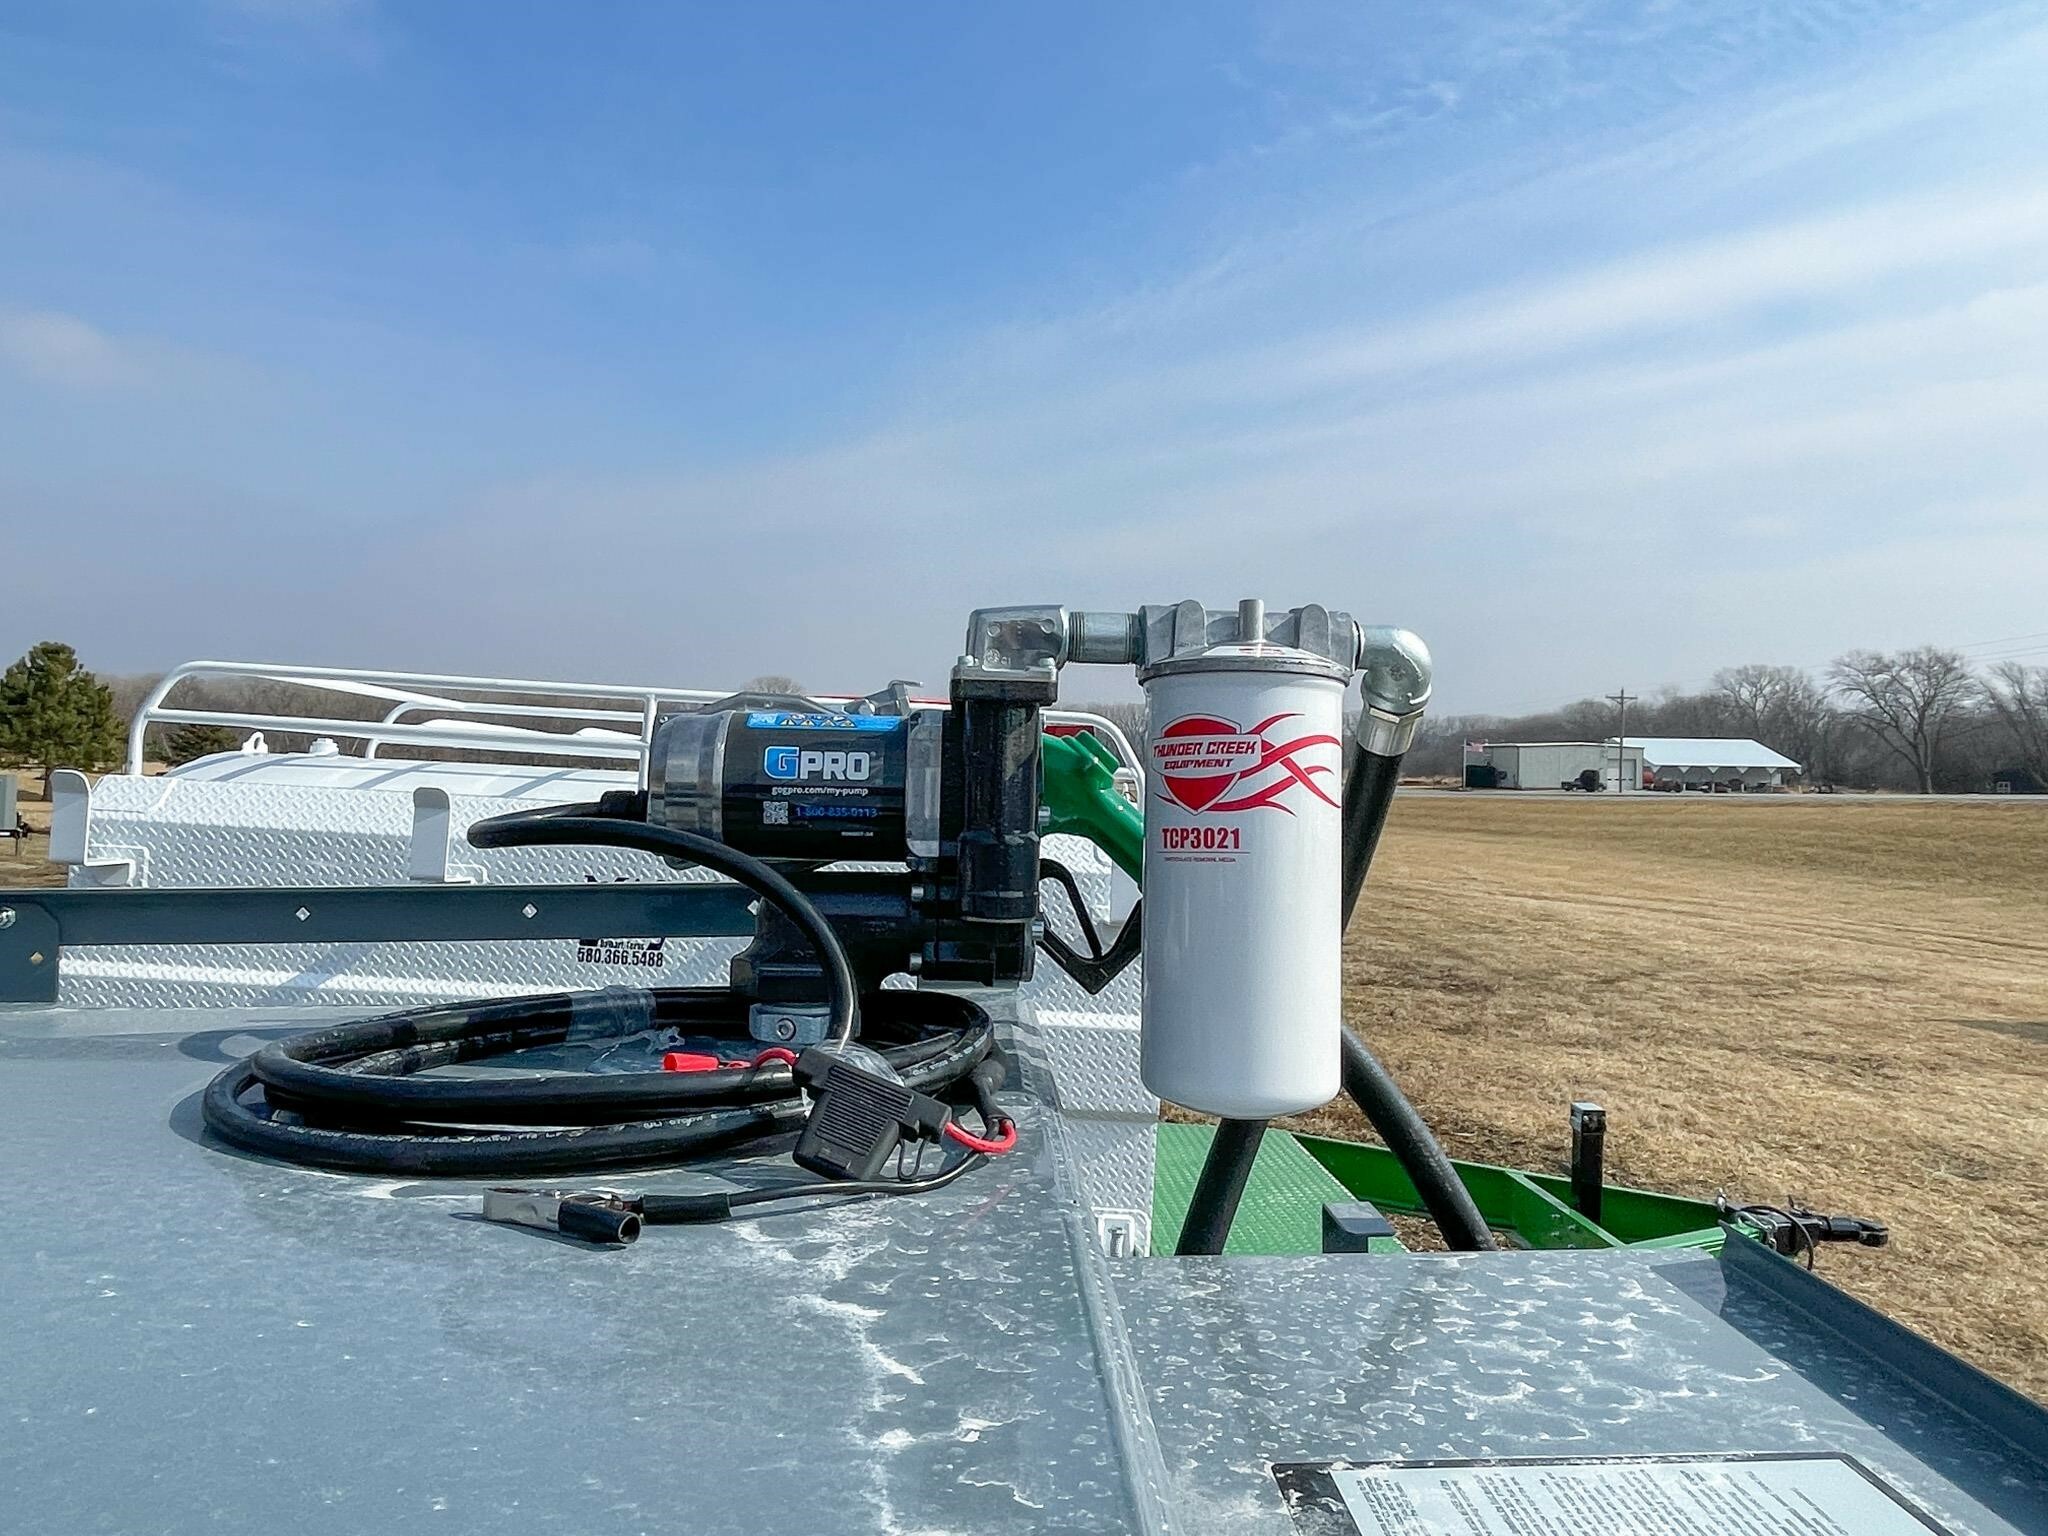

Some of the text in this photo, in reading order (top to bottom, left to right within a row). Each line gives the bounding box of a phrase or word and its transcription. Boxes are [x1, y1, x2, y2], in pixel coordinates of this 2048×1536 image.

[1153, 741, 1257, 758] THUNDER CREEK
[1164, 758, 1234, 770] EQUIPMENT
[1162, 828, 1240, 849] TCP3021
[577, 947, 664, 967] 580.366.5488
